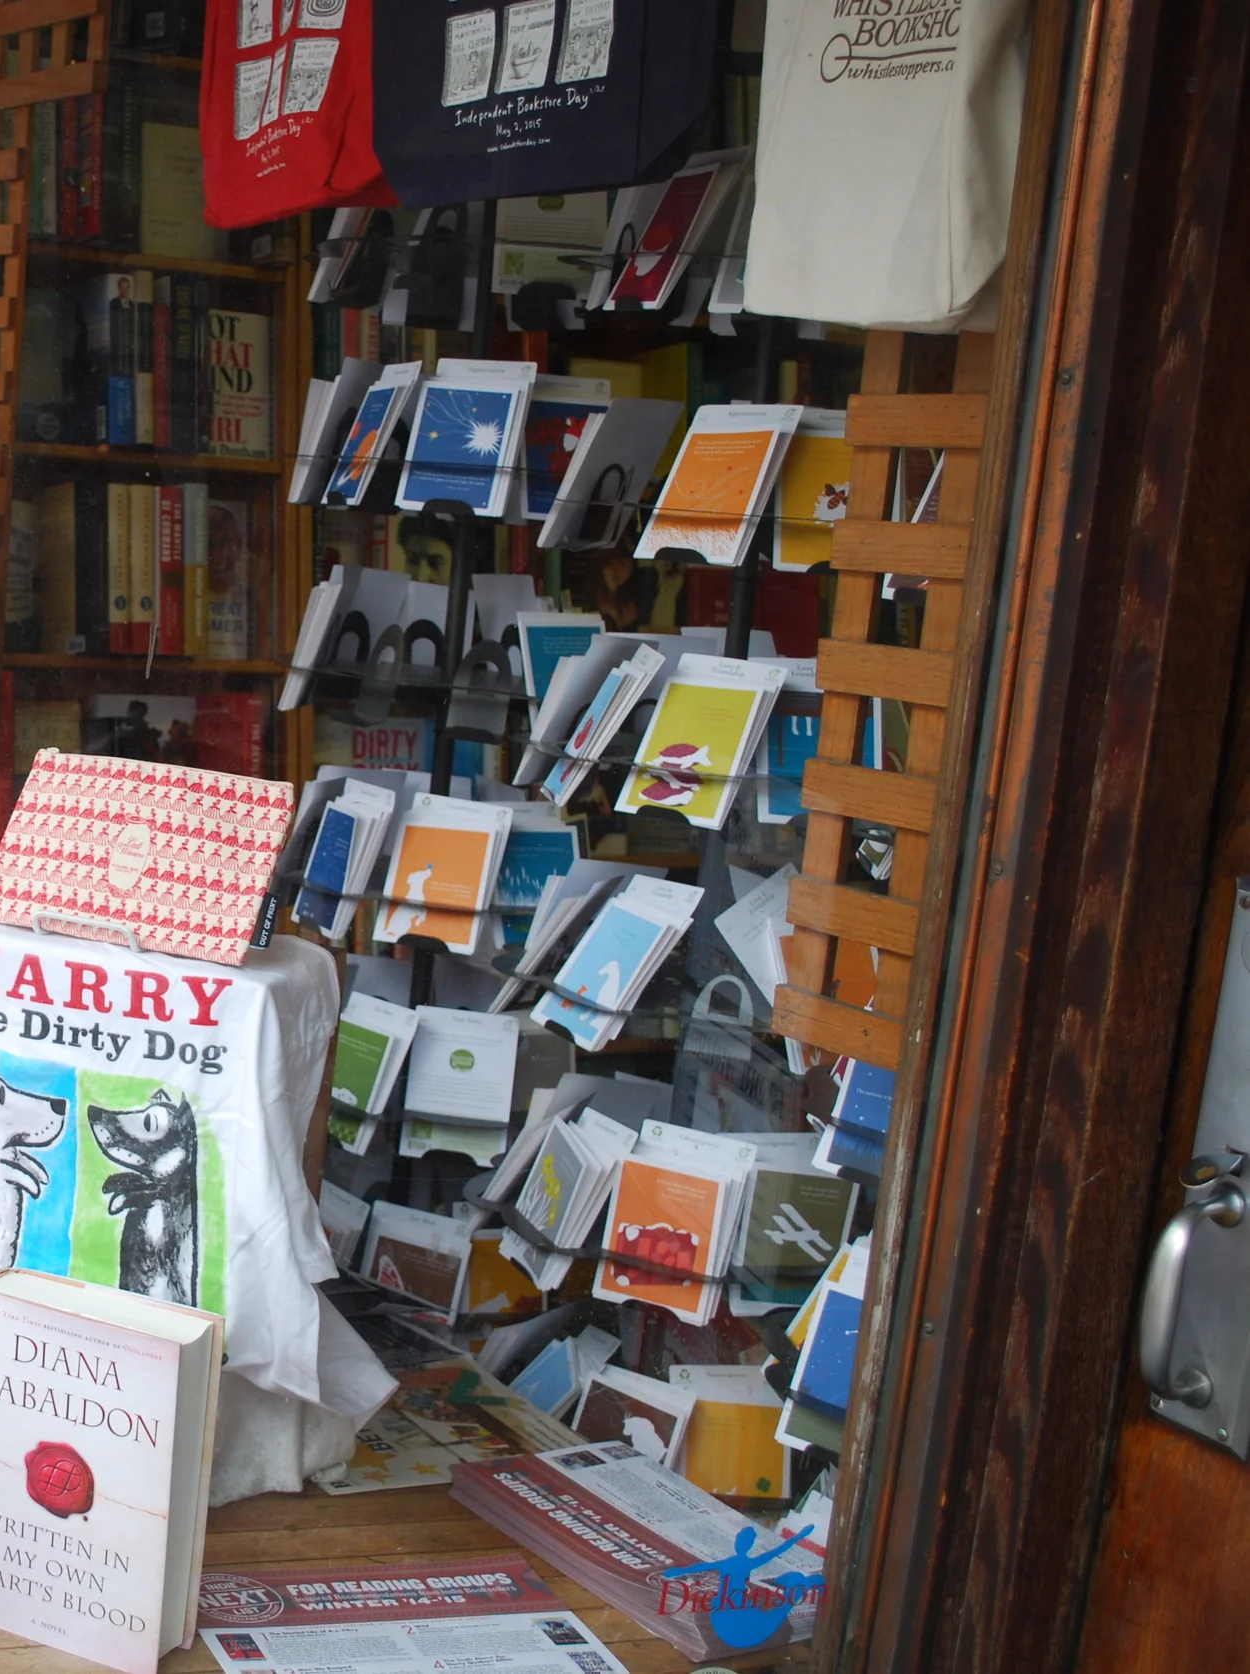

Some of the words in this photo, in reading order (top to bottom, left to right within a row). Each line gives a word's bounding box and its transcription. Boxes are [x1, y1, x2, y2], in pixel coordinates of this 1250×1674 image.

[852, 7, 961, 47] BOOKSHO
[454, 103, 513, 127] Independent
[517, 96, 562, 115] Bookstore
[566, 87, 589, 109] Day
[496, 125, 511, 137] May
[524, 118, 542, 130] 2015
[209, 315, 240, 341] OT
[209, 340, 254, 368] HAT
[208, 366, 253, 393] IND
[209, 416, 247, 443] IRL
[161, 514, 171, 562] COMMAND
[173, 524, 181, 562] MANTLE
[353, 729, 418, 760] DIRTY
[267, 896, 277, 921] PRINT
[263, 918, 271, 929] OF
[258, 930, 269, 946] OUT
[18, 1007, 132, 1062] Dirty
[143, 1028, 229, 1075] Dog
[43, 1324, 83, 1340] BESTSELLING
[85, 1336, 110, 1347] AUTHOR
[12, 1333, 124, 1393] DIANA
[3, 1545, 39, 1571] MY
[45, 1558, 106, 1594] OWN
[103, 1548, 131, 1574] IN
[204, 1581, 239, 1591] INDIE
[285, 1581, 328, 1597] FOR
[338, 1577, 425, 1595] READING
[430, 1571, 513, 1590] GROUPS
[658, 1575, 830, 1616] Dickinson
[62, 1593, 147, 1634] BLOOD
[233, 1604, 261, 1616] LIST
[299, 1598, 400, 1612] WINTER
[30, 1617, 37, 1626] A
[41, 1621, 69, 1638] NOVEL
